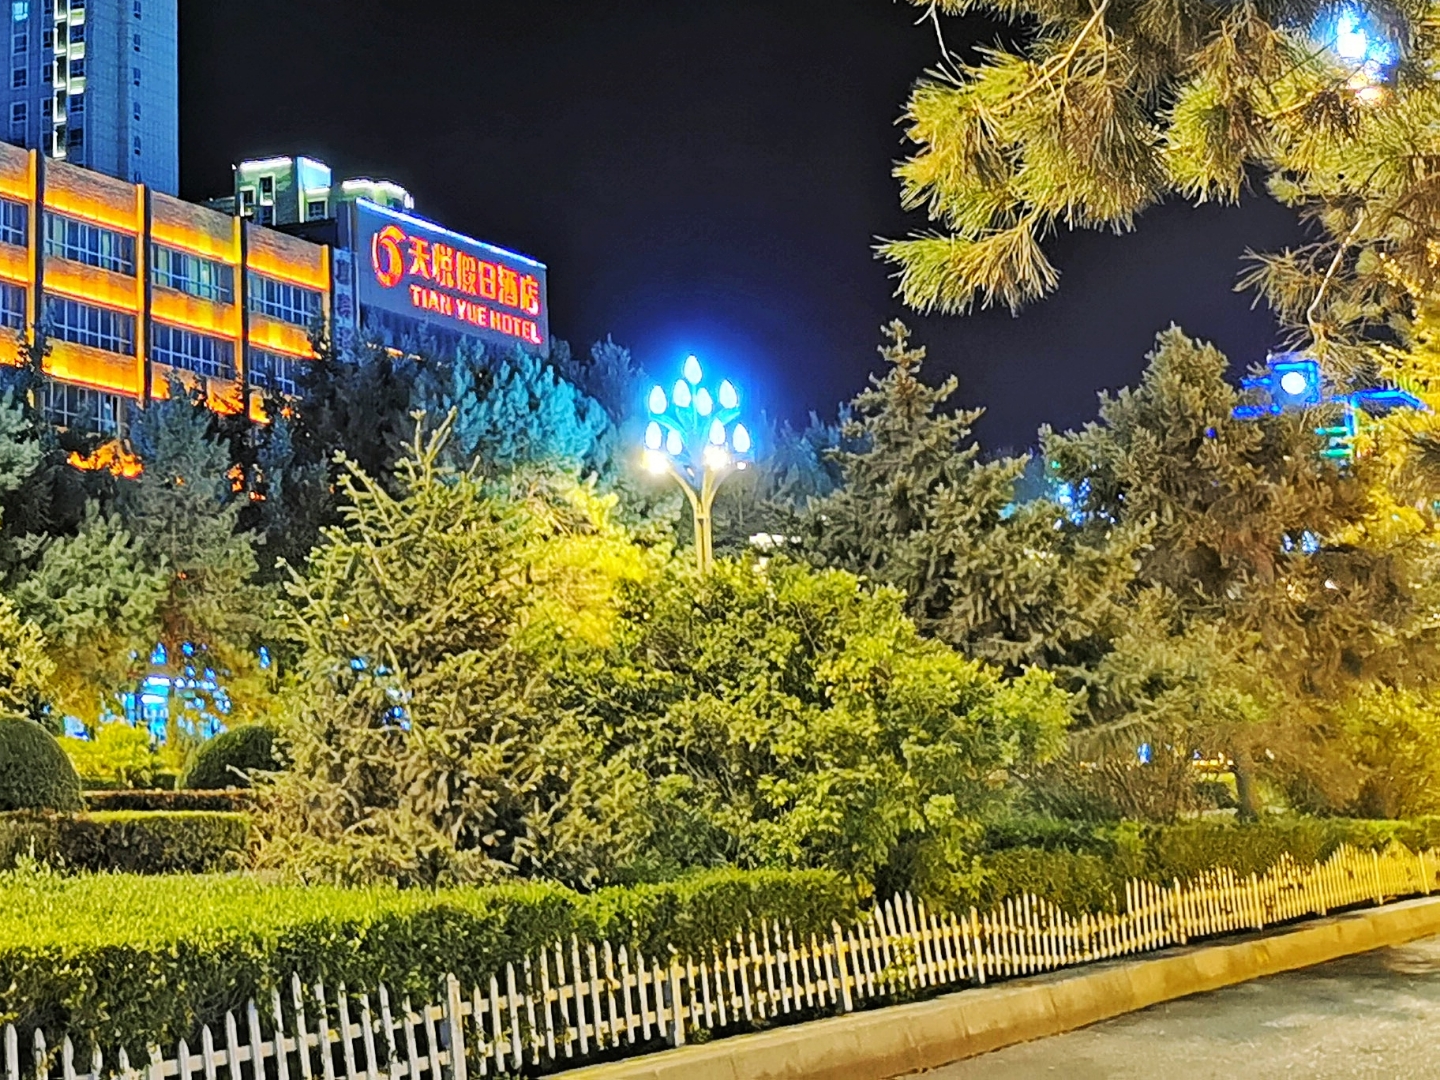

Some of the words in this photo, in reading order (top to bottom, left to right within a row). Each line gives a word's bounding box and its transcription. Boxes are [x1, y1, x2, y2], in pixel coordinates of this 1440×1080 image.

[408, 235, 541, 316] 天悦假日酒店
[410, 283, 453, 317] TIAN
[455, 299, 489, 328] YUE
[489, 309, 543, 345] HOTEL
